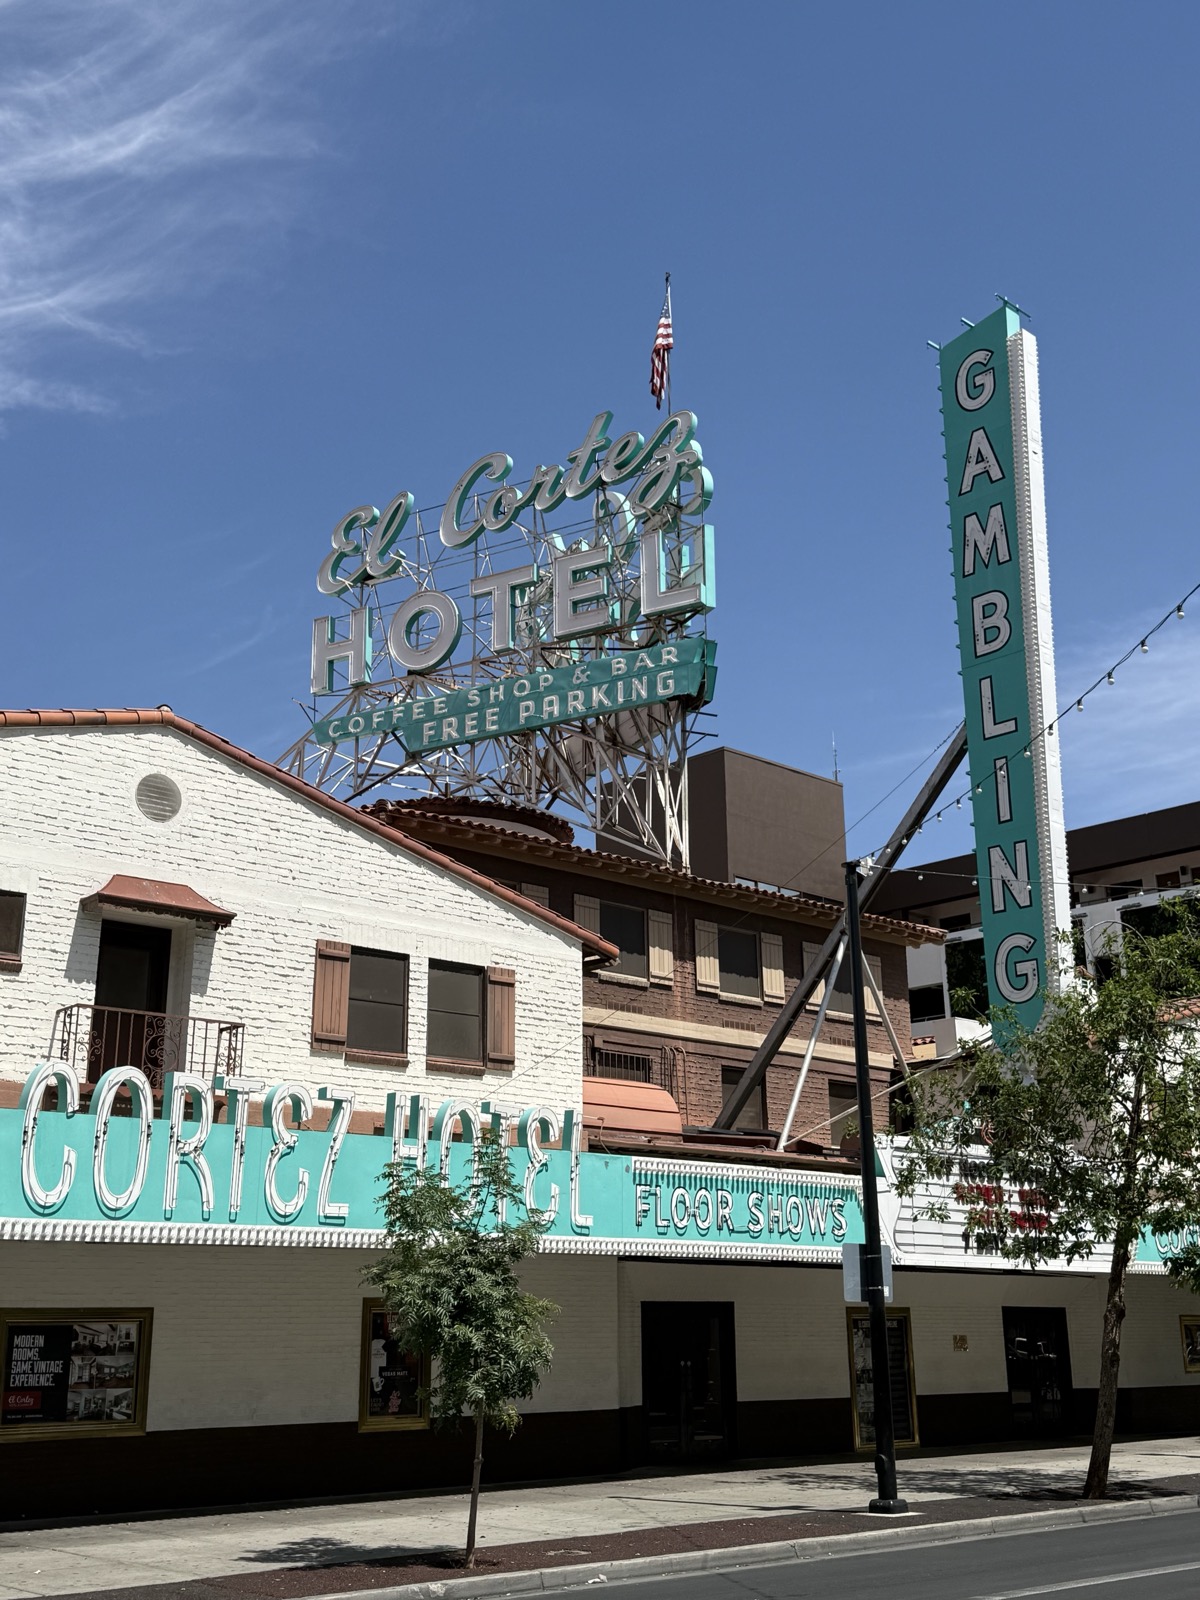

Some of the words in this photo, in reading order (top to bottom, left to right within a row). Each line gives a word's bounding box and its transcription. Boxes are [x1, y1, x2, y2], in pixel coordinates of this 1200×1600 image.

[316, 490, 416, 597] El
[439, 409, 703, 549] Cortez
[310, 527, 704, 696] HOTEL
[328, 697, 448, 739] COFFEE
[467, 673, 555, 708] SHOP
[572, 665, 592, 684] &
[610, 645, 679, 677] BAR
[422, 708, 501, 746] FREE
[519, 669, 676, 726] PARKING
[954, 348, 1039, 1004] GAMBLING
[20, 1060, 351, 1218] CORTEZ
[635, 1184, 734, 1231] FLOOR
[746, 1190, 848, 1237] SHOWS
[11, 1360, 33, 1374] SAME
[33, 1361, 63, 1373] VINTAGE
[12, 1348, 40, 1360] ROOMS.
[13, 1335, 45, 1348] MODERN
[10, 1374, 55, 1387] EXPERIENCE.
